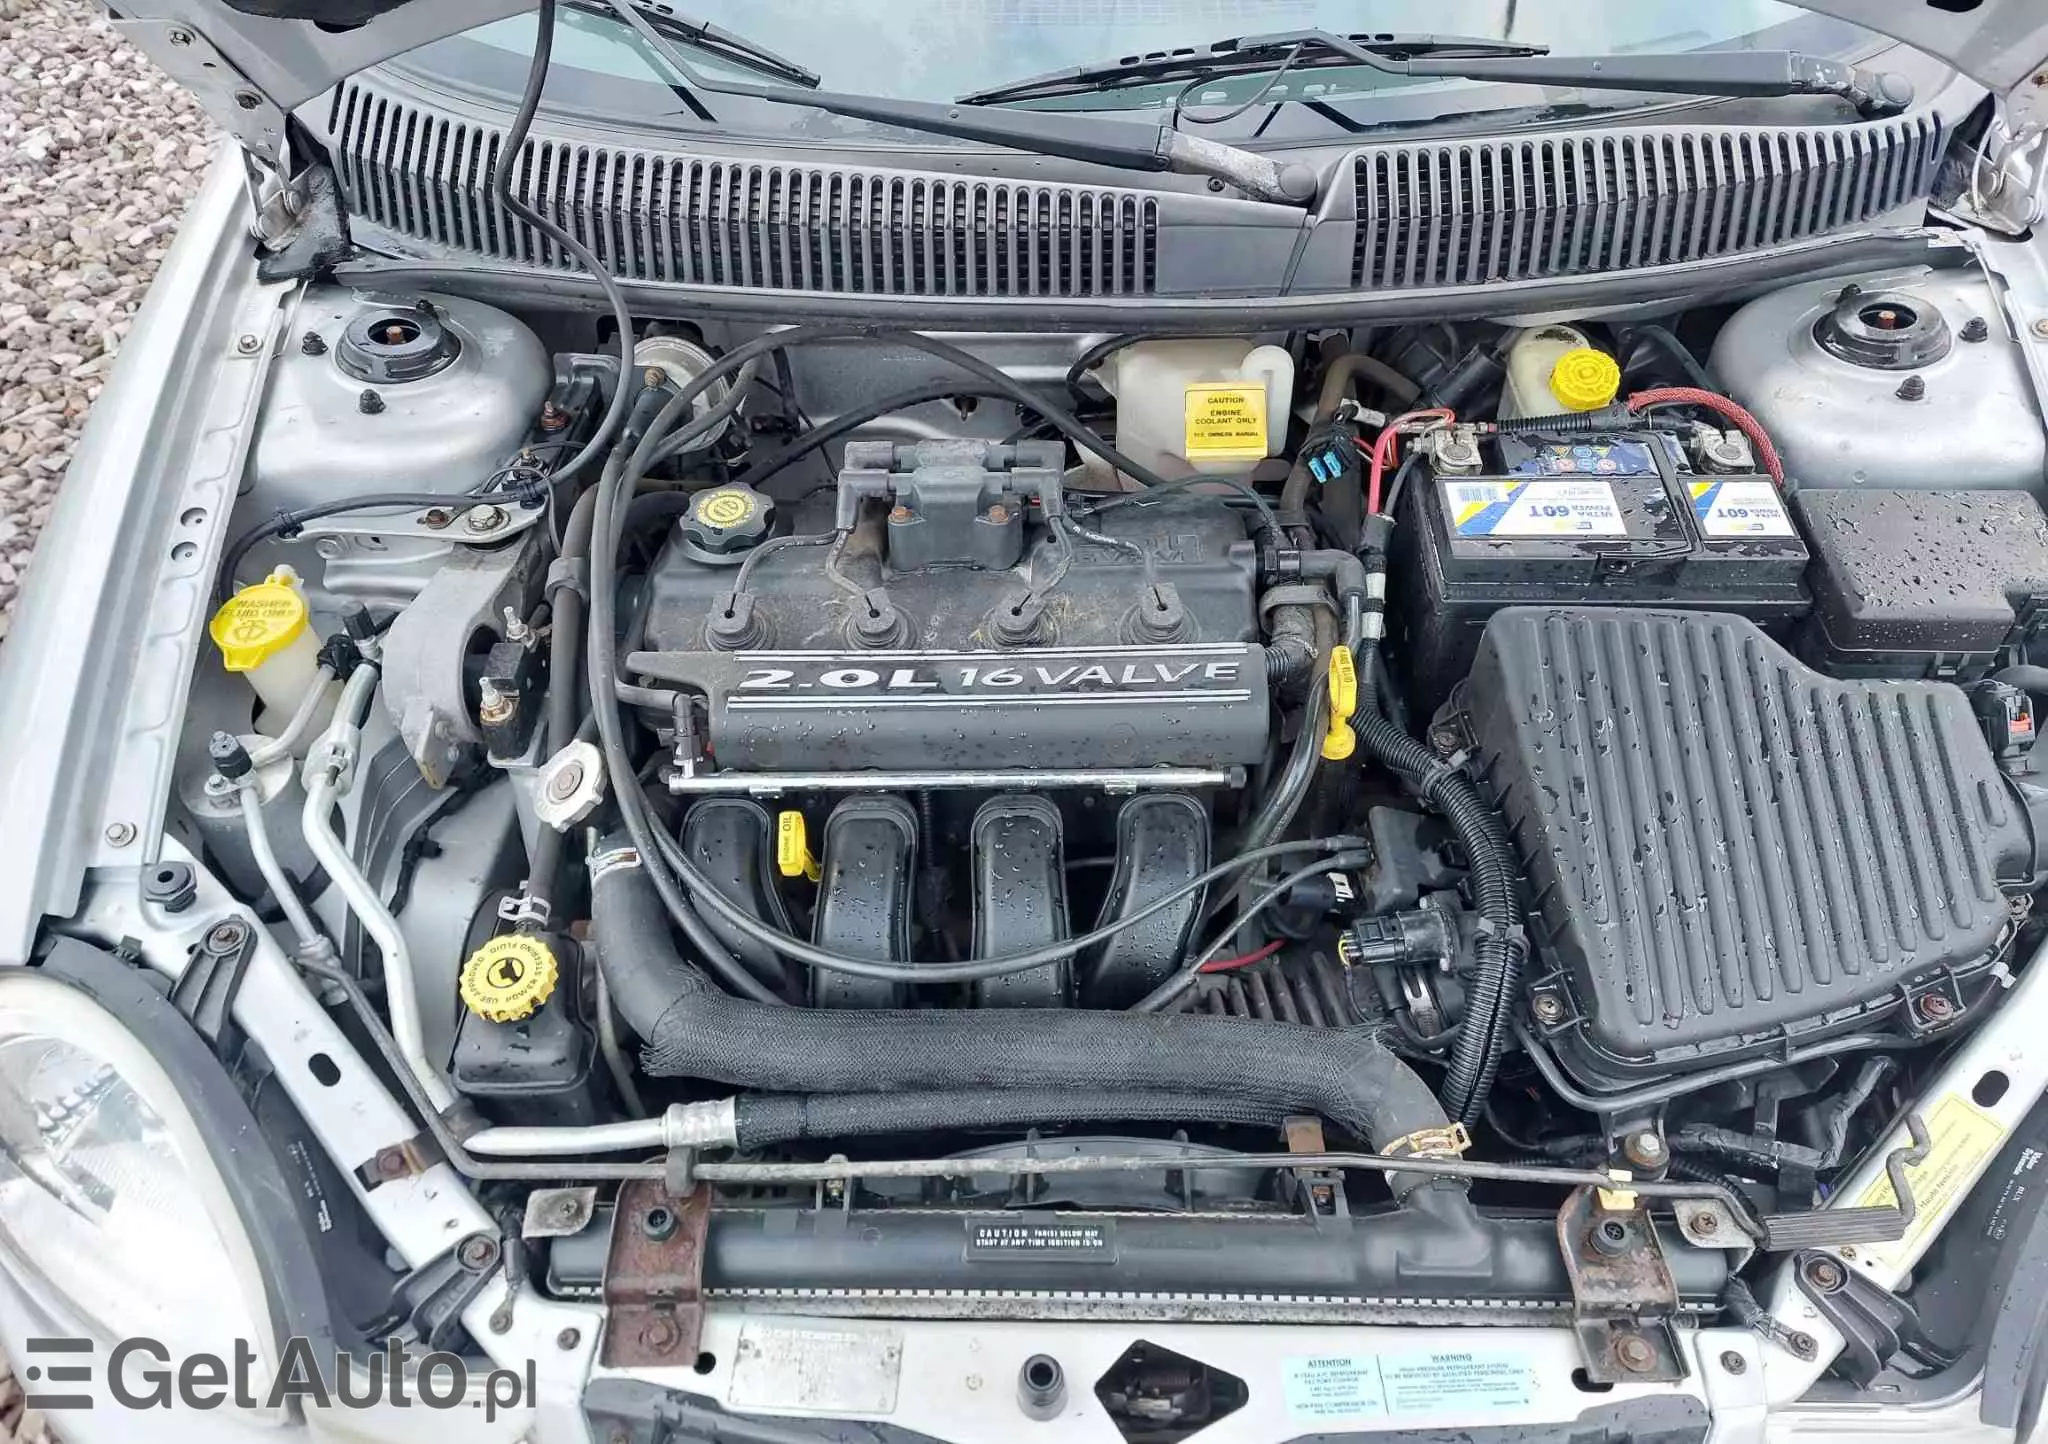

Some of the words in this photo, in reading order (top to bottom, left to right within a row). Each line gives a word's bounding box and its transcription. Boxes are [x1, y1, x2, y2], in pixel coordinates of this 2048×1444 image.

[1210, 409, 1242, 417] ENGINE
[1194, 417, 1233, 425] COOLANT
[1529, 505, 1570, 518] 60T
[1717, 508, 1749, 519] 60T
[237, 599, 292, 609] WASHER
[739, 668, 939, 690] 2.0L
[959, 667, 1024, 688] 16
[1034, 662, 1241, 687] VALVE
[782, 813, 793, 832] OIL
[979, 1228, 1029, 1238] CAUTION
[1059, 1229, 1083, 1238] BELOW
[1011, 1238, 1026, 1247] ANY
[1027, 1238, 1045, 1247] TIME
[1430, 1353, 1473, 1363] WARNING
[1307, 1358, 1352, 1369] ATTENTION
